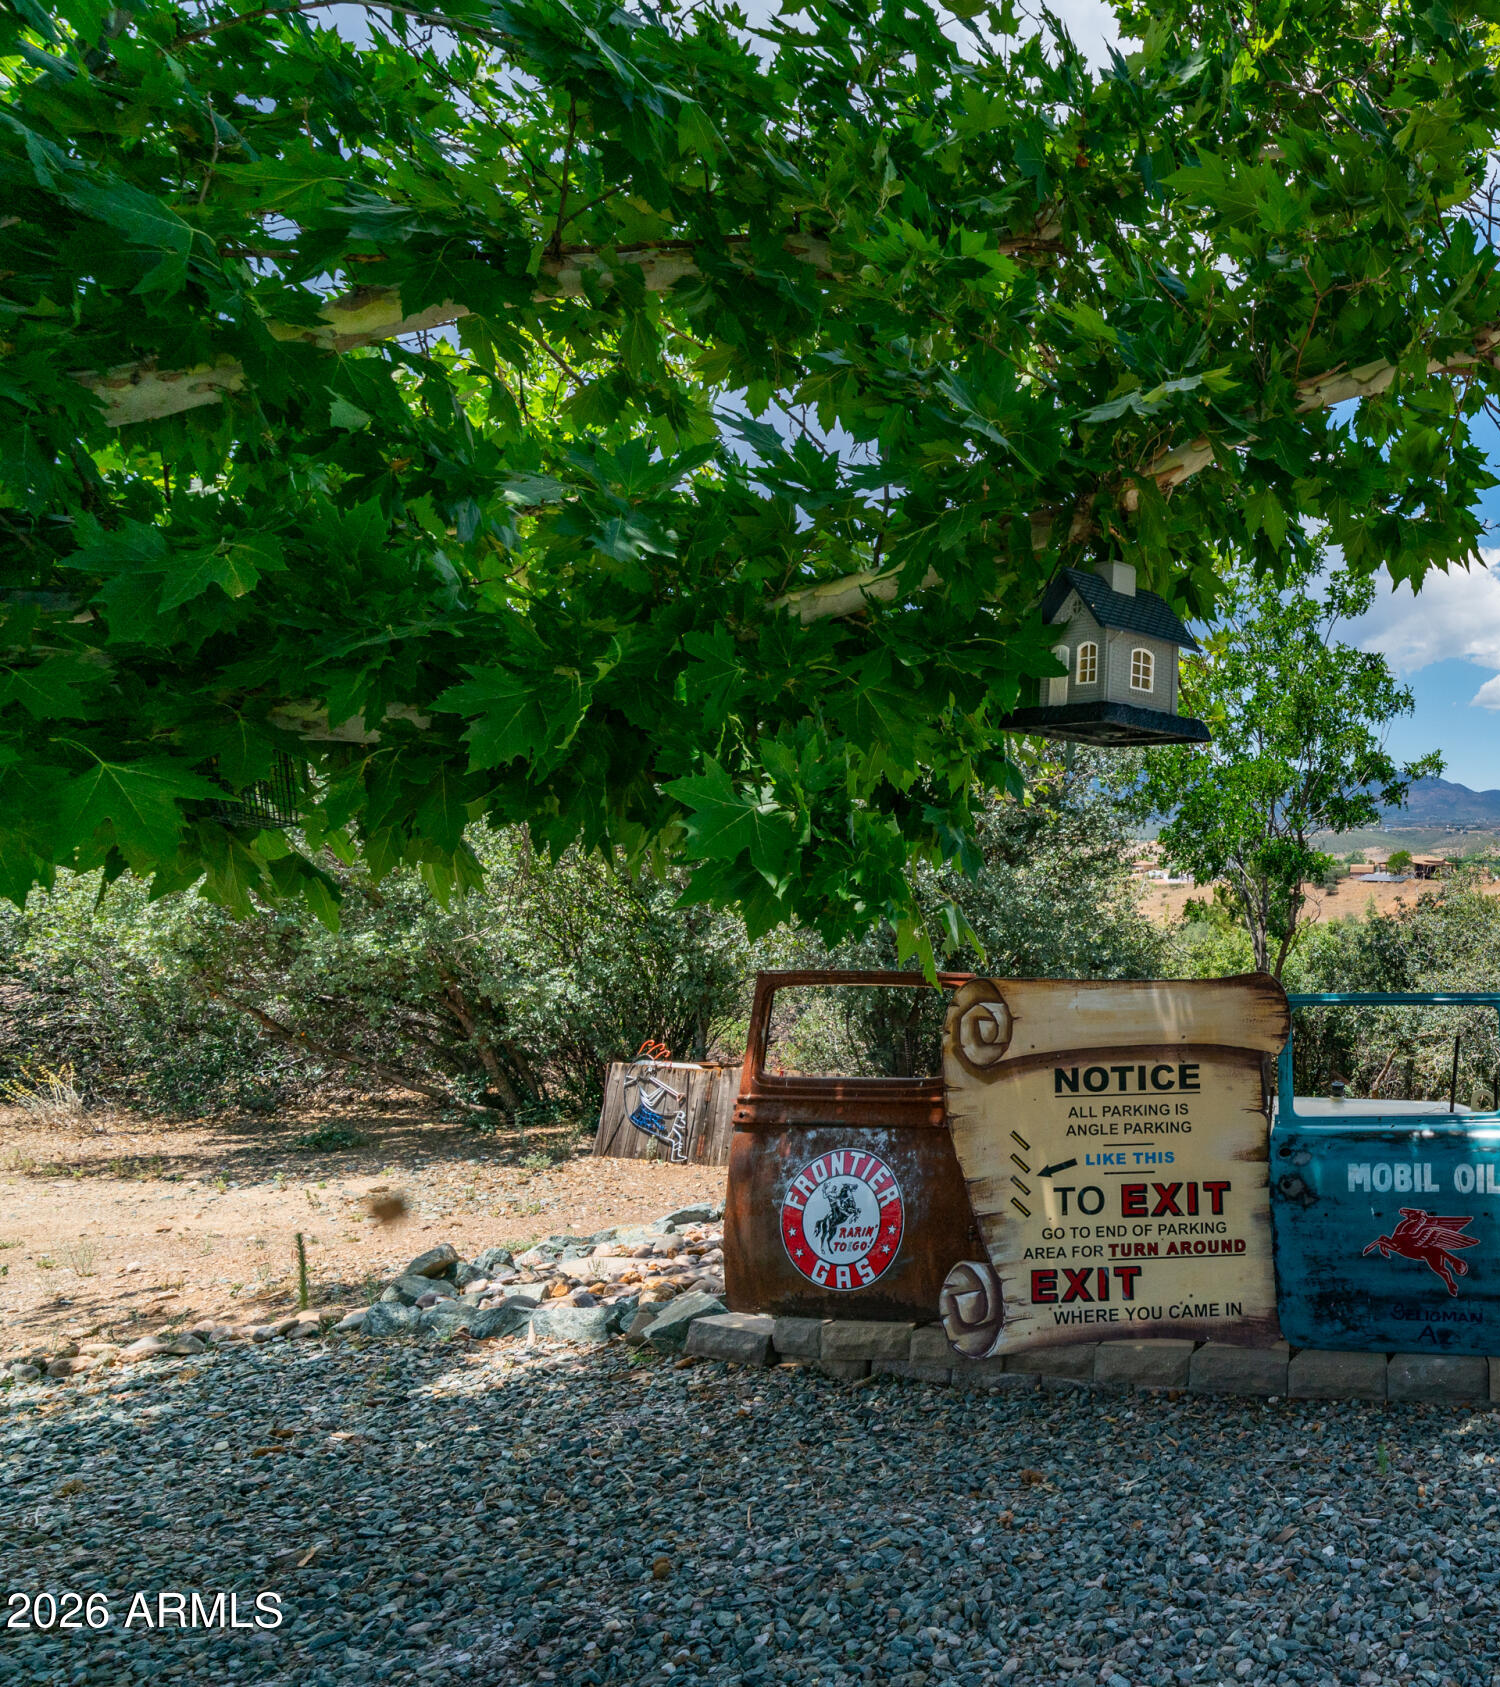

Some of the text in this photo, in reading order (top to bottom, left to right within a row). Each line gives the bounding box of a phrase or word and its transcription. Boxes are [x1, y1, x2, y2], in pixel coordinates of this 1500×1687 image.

[1054, 1064, 1200, 1093] NOTICE
[1068, 1103, 1189, 1118] ALL PARKING IS
[1066, 1121, 1192, 1136] ANGLE PARKING
[1085, 1152, 1175, 1166] LIKE THIS
[785, 1151, 901, 1211] FRONTIER
[1348, 1163, 1439, 1193] MOBIL
[1054, 1181, 1231, 1218] TO EXIT
[1041, 1222, 1227, 1240] GO TO END OF PARKING
[834, 1239, 873, 1252] TO GO!
[1023, 1239, 1246, 1260] AREA FOR TURN AROUND
[811, 1258, 876, 1288] GAS
[1031, 1266, 1142, 1304] EXIT
[1053, 1302, 1242, 1325] WHERE YOU CAME IN
